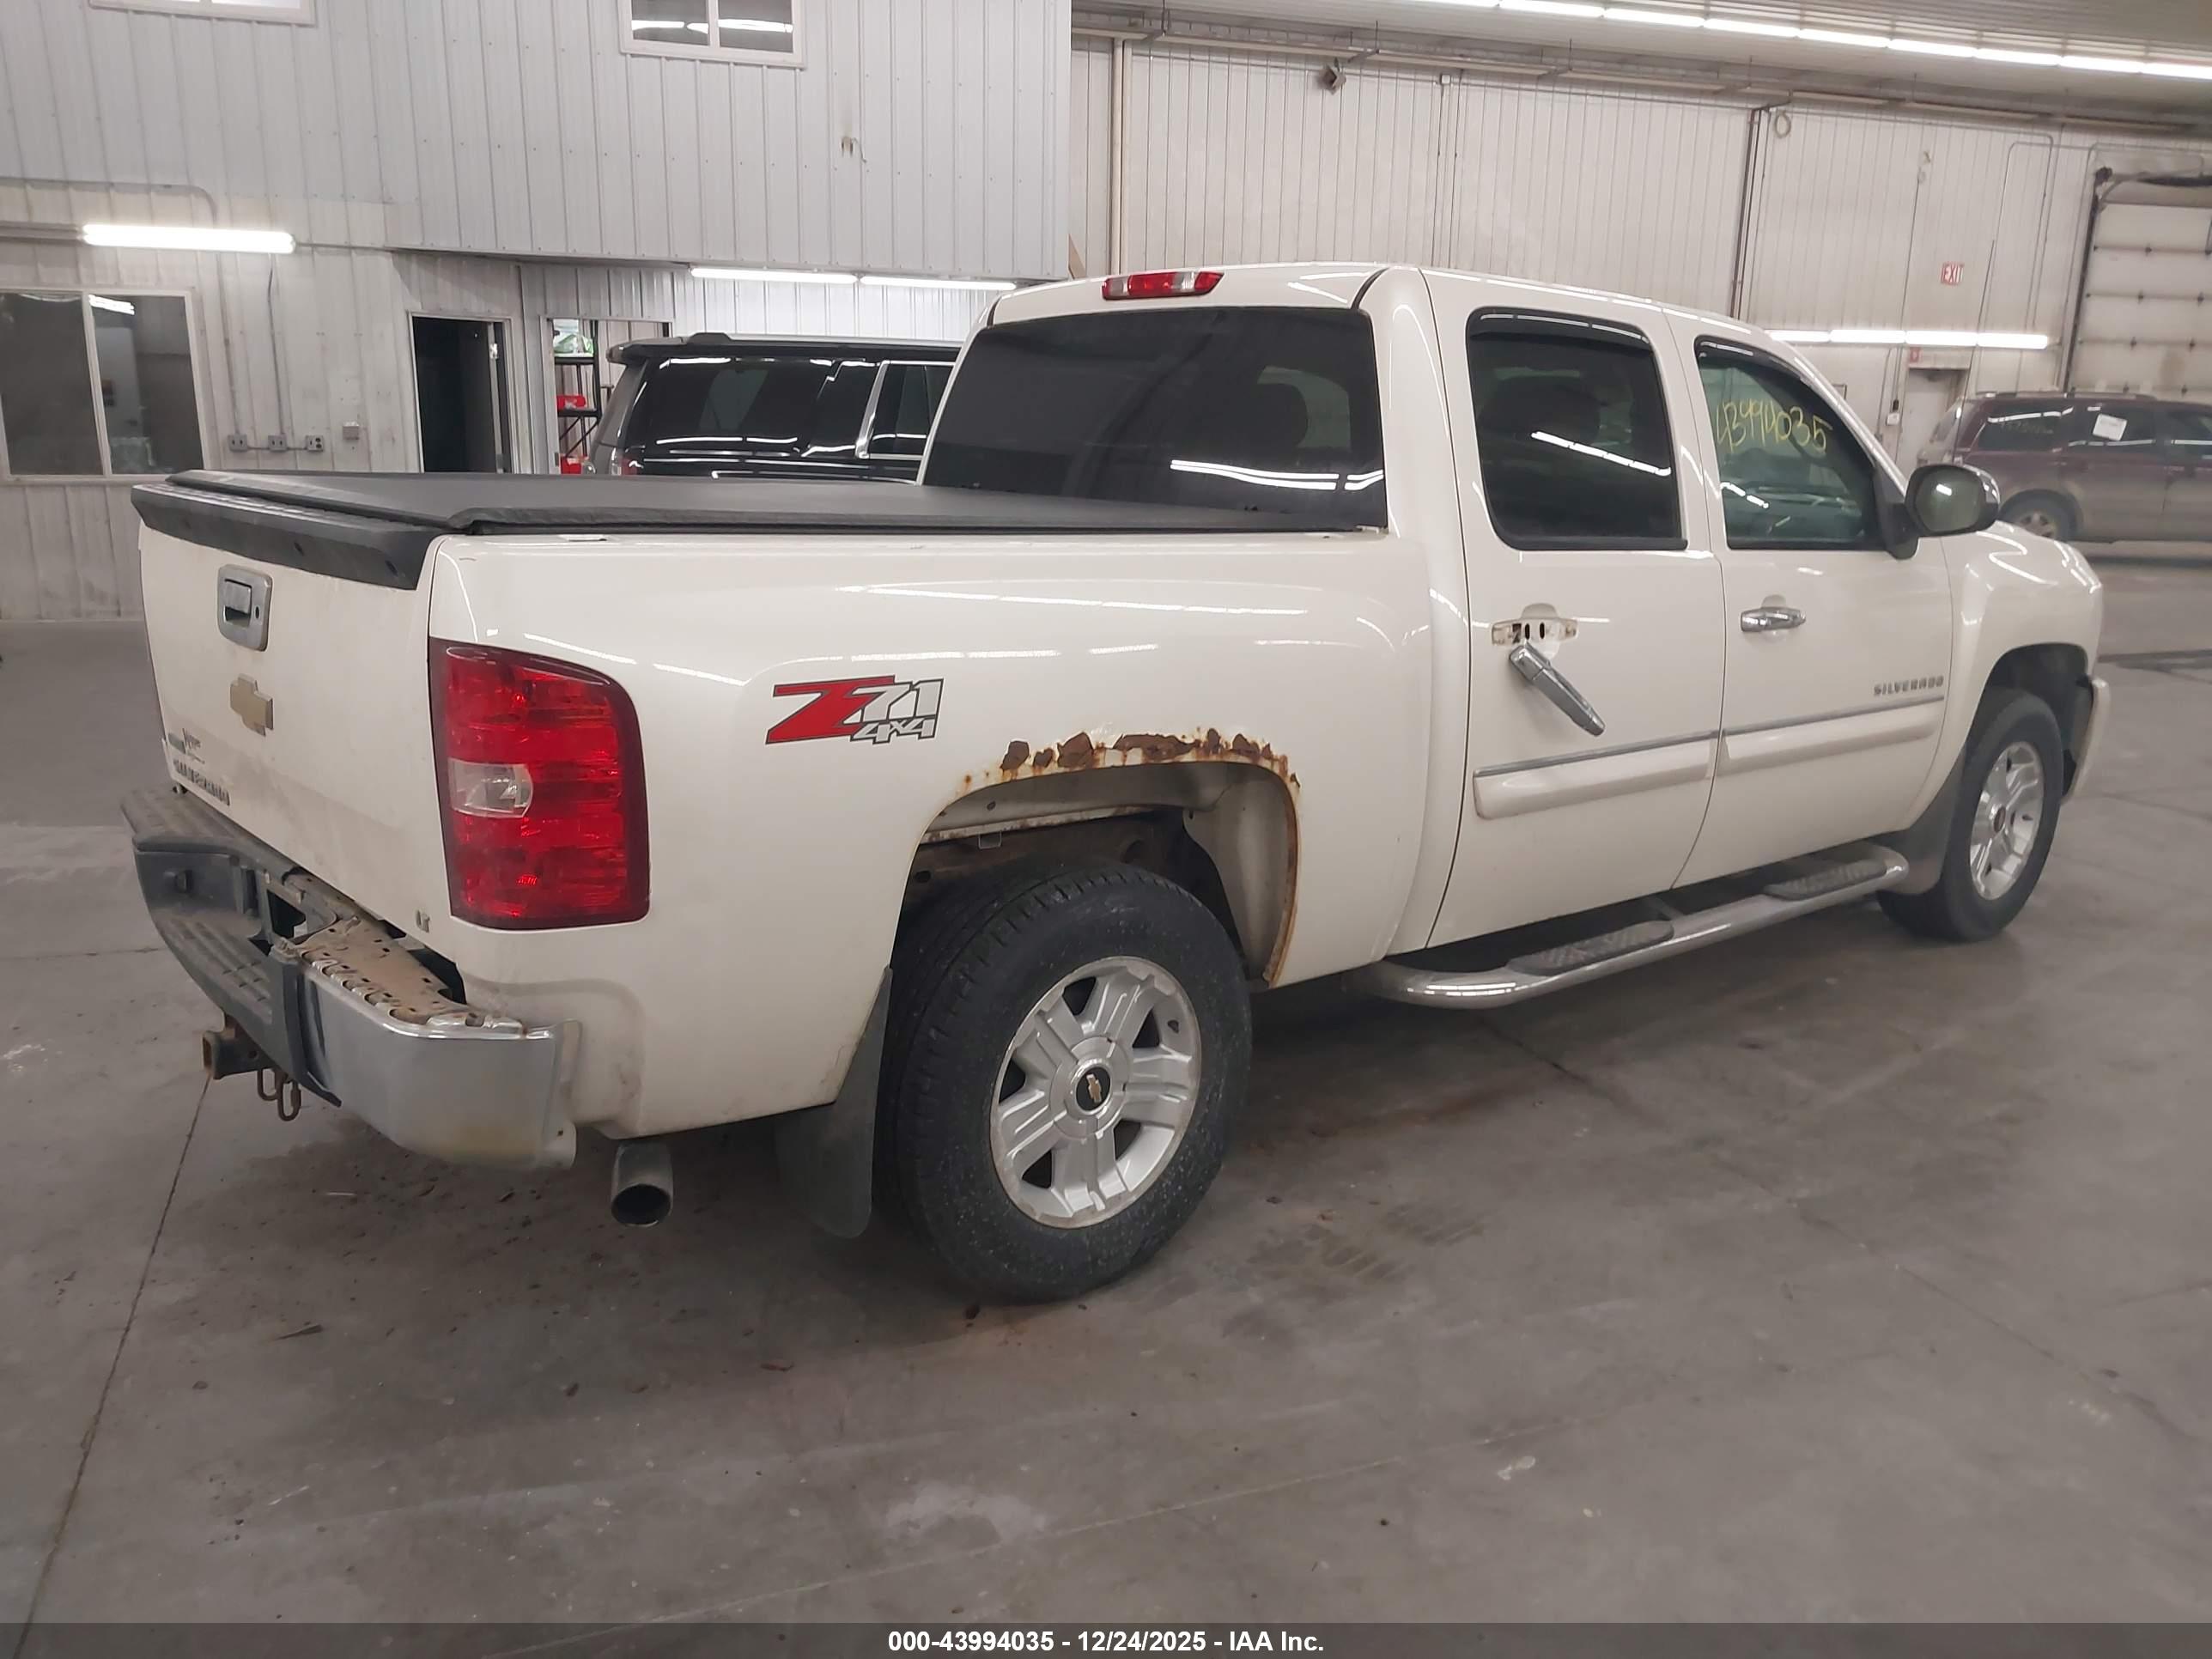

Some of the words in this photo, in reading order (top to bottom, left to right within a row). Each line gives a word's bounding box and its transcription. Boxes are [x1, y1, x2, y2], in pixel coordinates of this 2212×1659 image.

[1942, 263, 1965, 283] EXIT
[1874, 675, 1944, 696] SILVERADO
[765, 674, 944, 744] Z71
